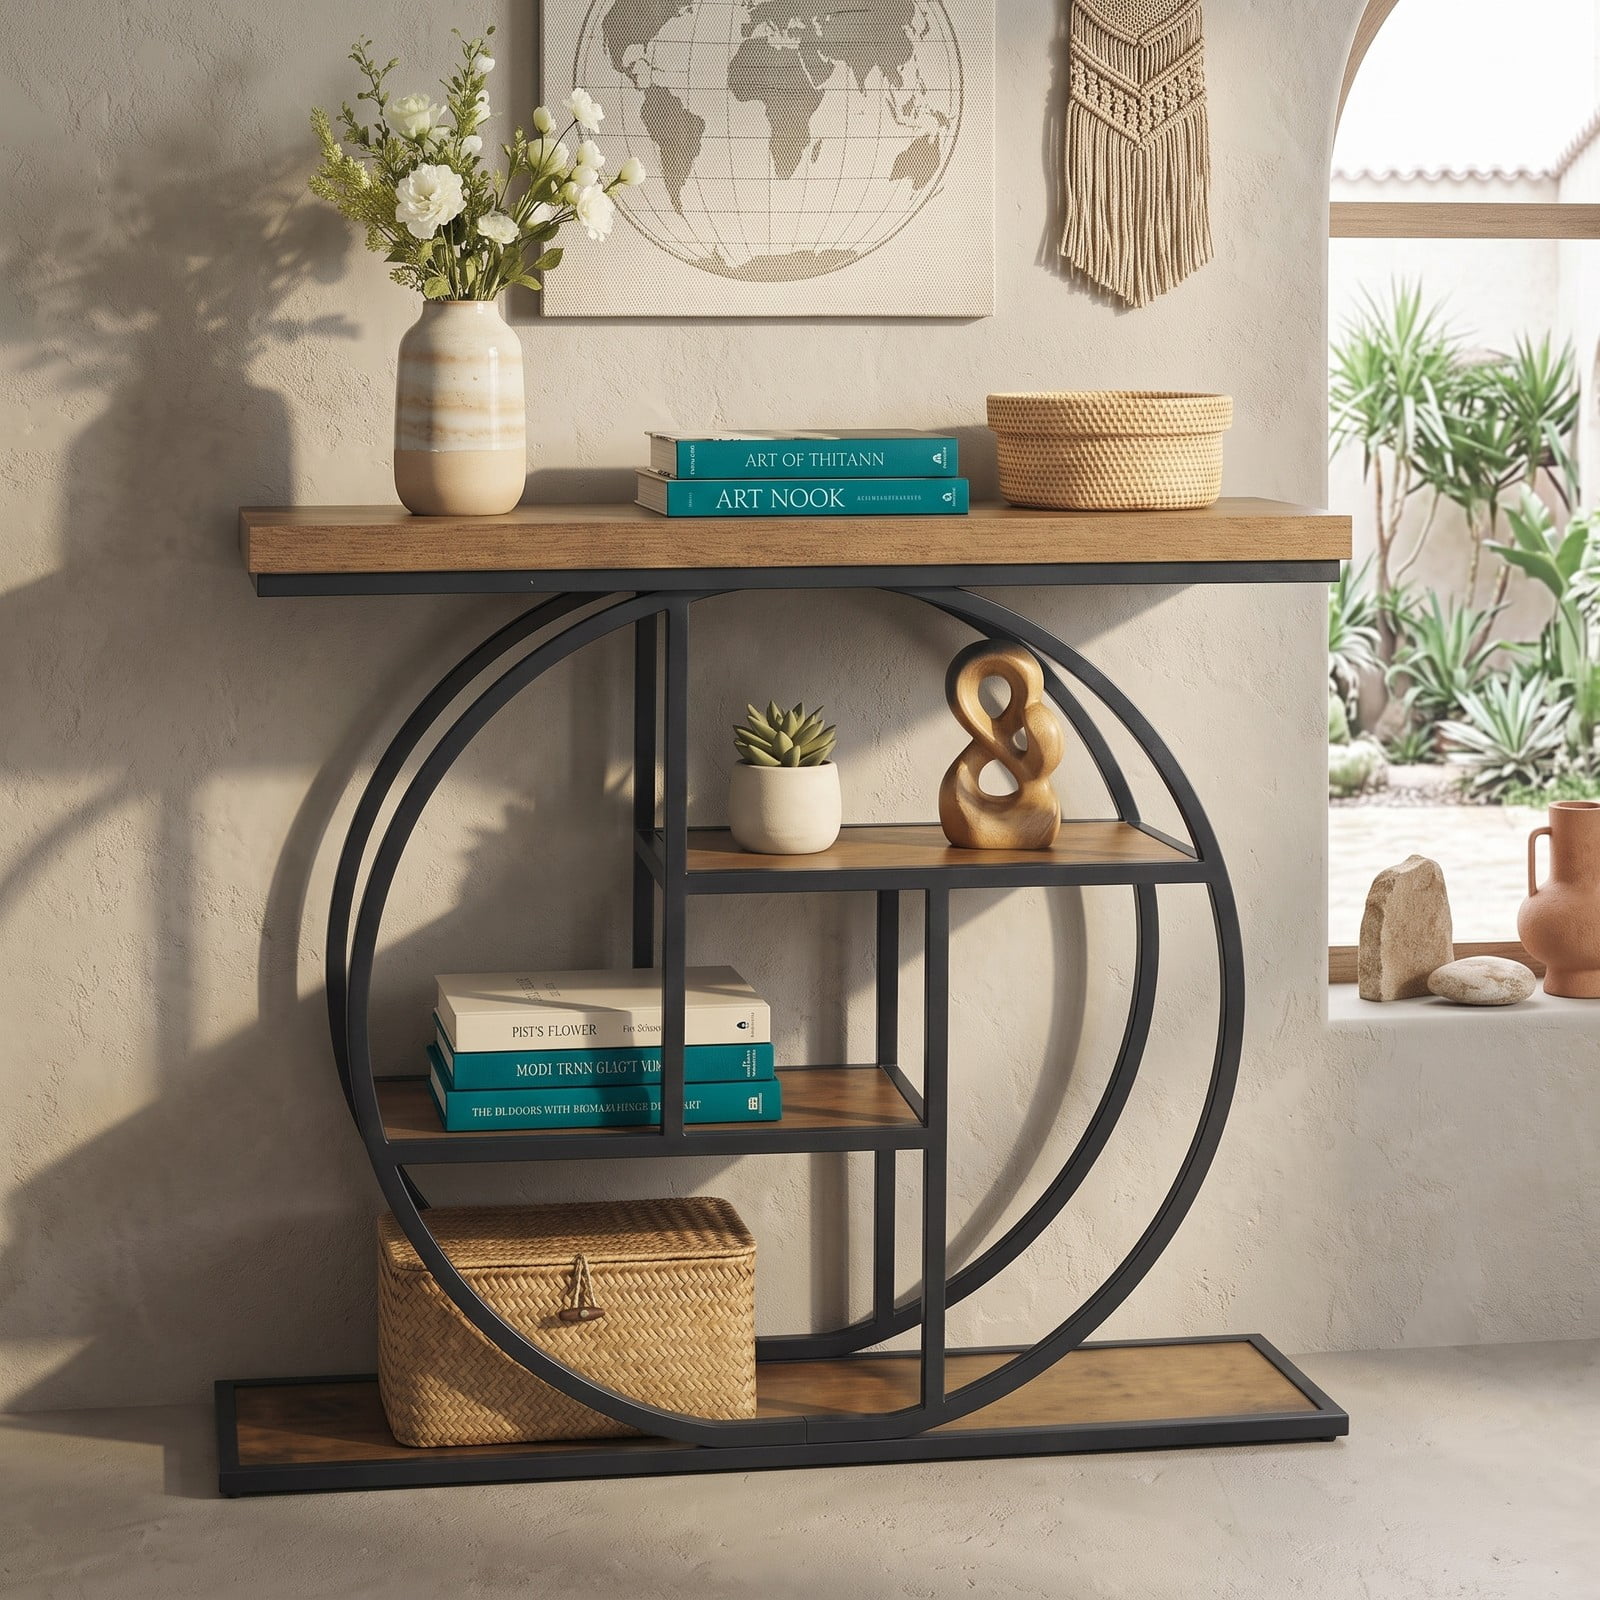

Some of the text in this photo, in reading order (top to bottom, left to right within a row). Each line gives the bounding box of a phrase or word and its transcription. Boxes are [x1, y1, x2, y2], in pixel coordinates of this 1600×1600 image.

[745, 452, 884, 468] ART OF THITANN
[715, 488, 763, 509] ART
[771, 487, 846, 508] NOOK
[512, 1023, 597, 1038] PIST'S FLOWER
[516, 1062, 552, 1077] MODI
[556, 1061, 593, 1075] TRNN
[472, 1107, 493, 1117] THE
[544, 1104, 570, 1114] WITH
